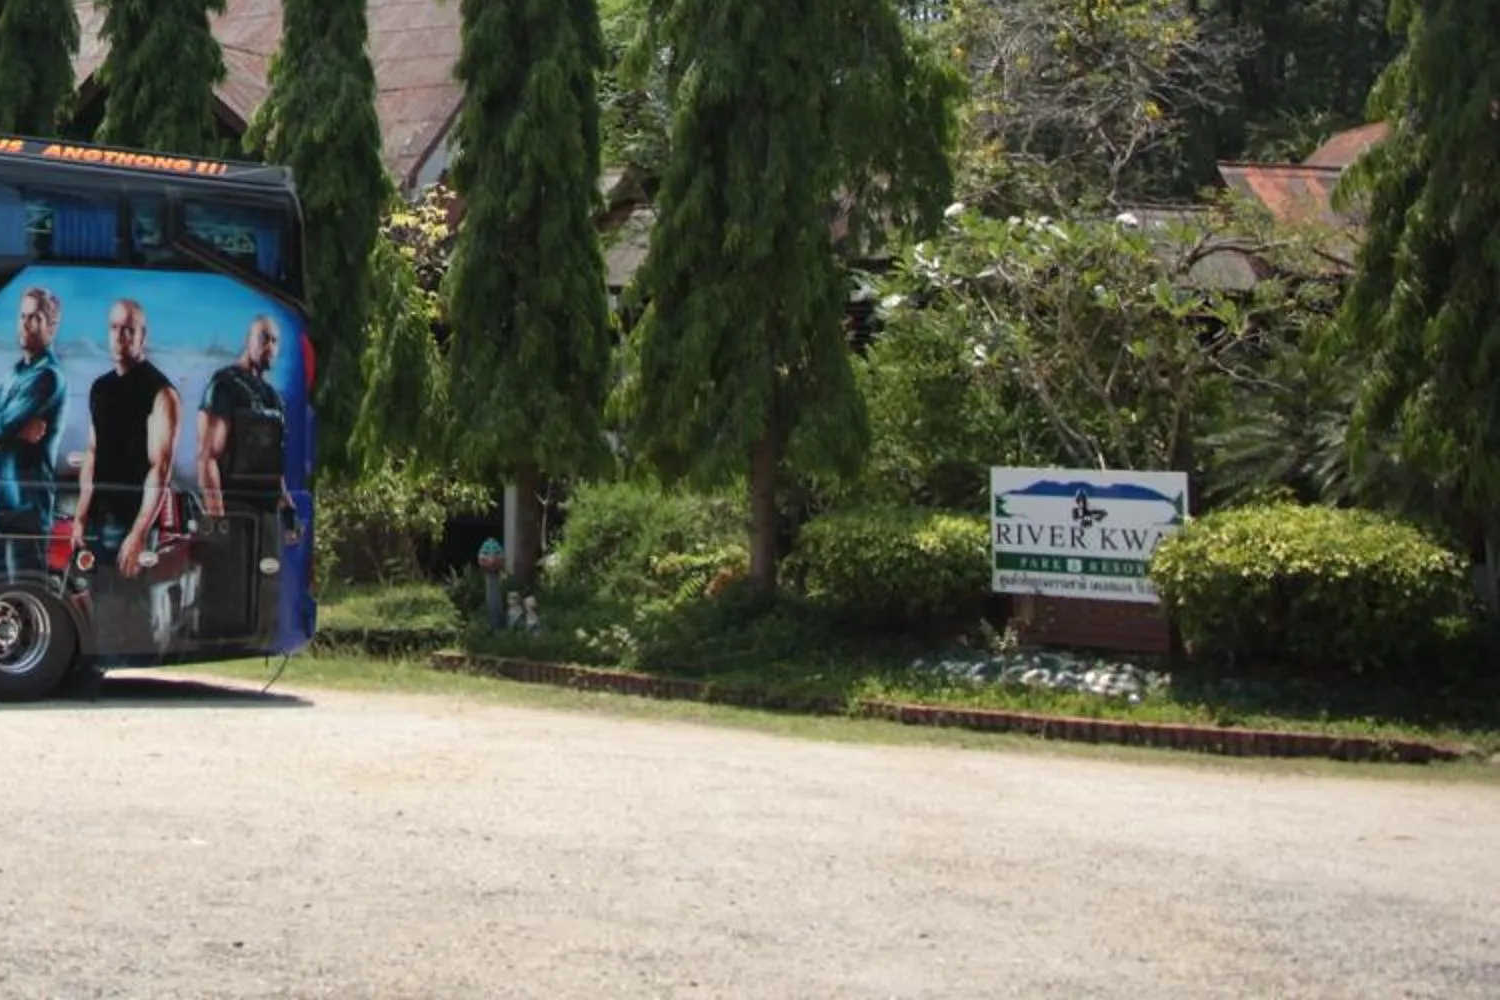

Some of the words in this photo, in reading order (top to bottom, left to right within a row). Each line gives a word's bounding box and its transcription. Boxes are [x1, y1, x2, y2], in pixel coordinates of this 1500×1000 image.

[42, 144, 192, 173] ANGTHONG
[996, 523, 1087, 549] RIVER
[1020, 557, 1062, 571] PARK
